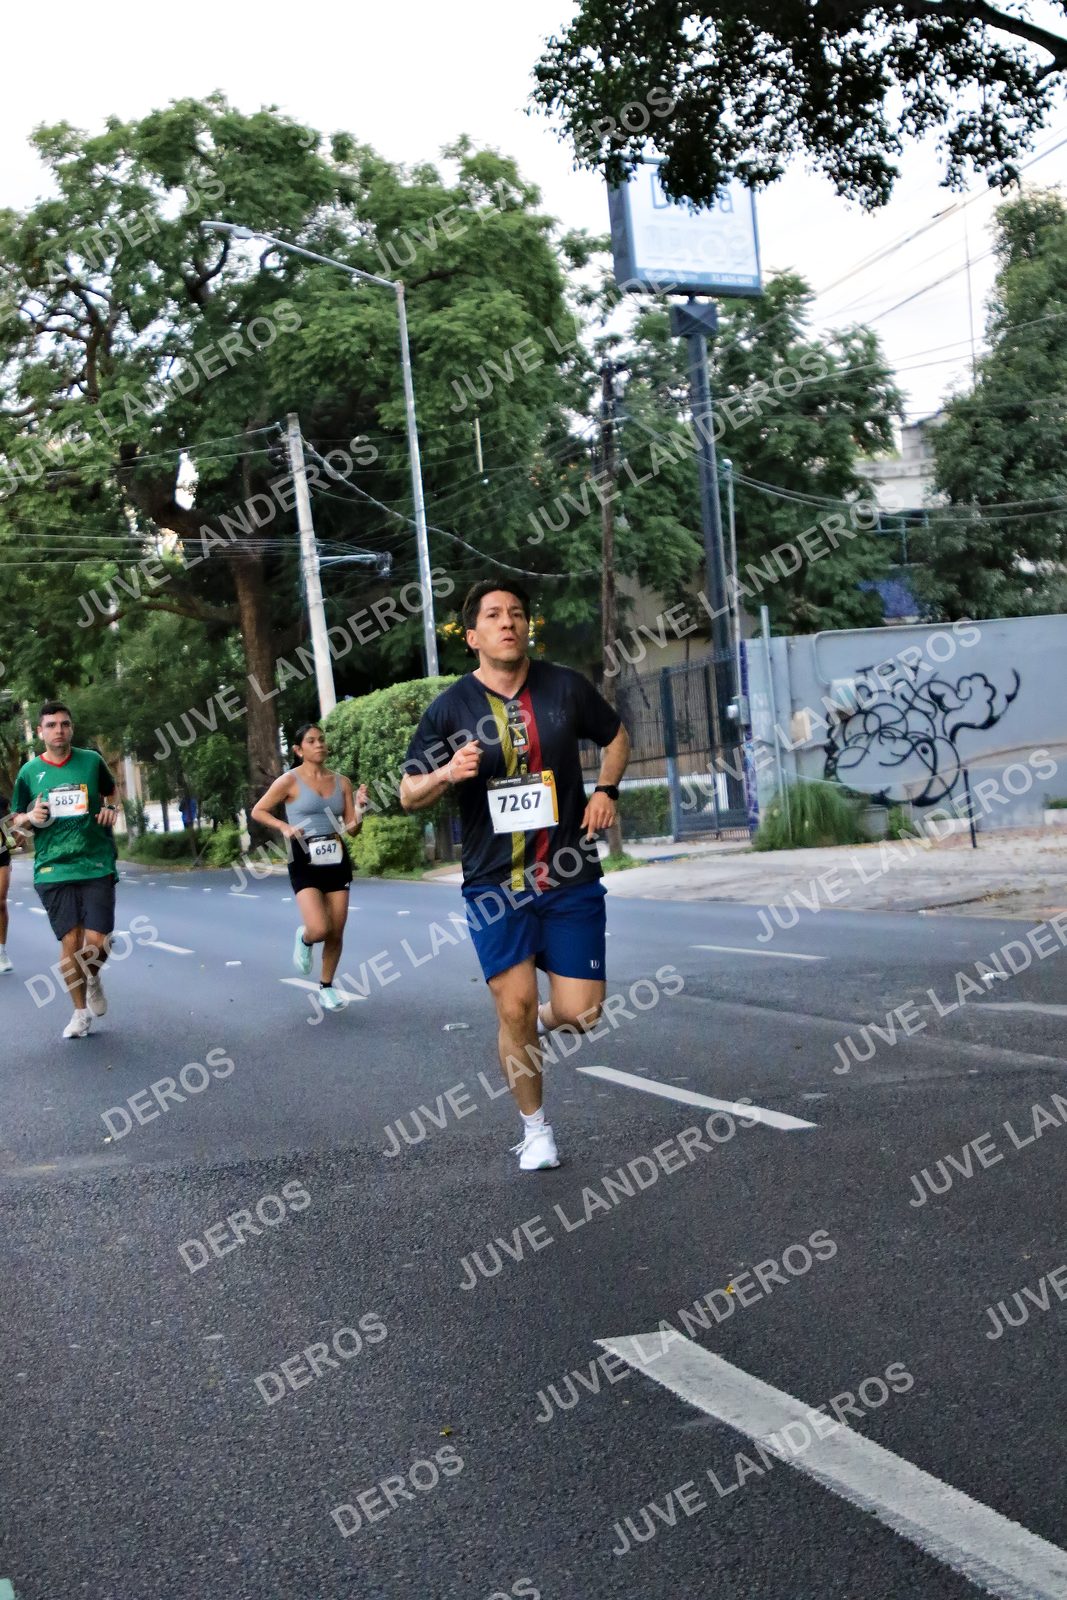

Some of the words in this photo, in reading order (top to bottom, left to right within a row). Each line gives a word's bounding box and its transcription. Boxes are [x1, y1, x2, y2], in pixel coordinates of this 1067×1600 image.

[55, 794, 80, 806] 5857
[498, 791, 542, 813] 7267
[315, 843, 337, 855] 6547
